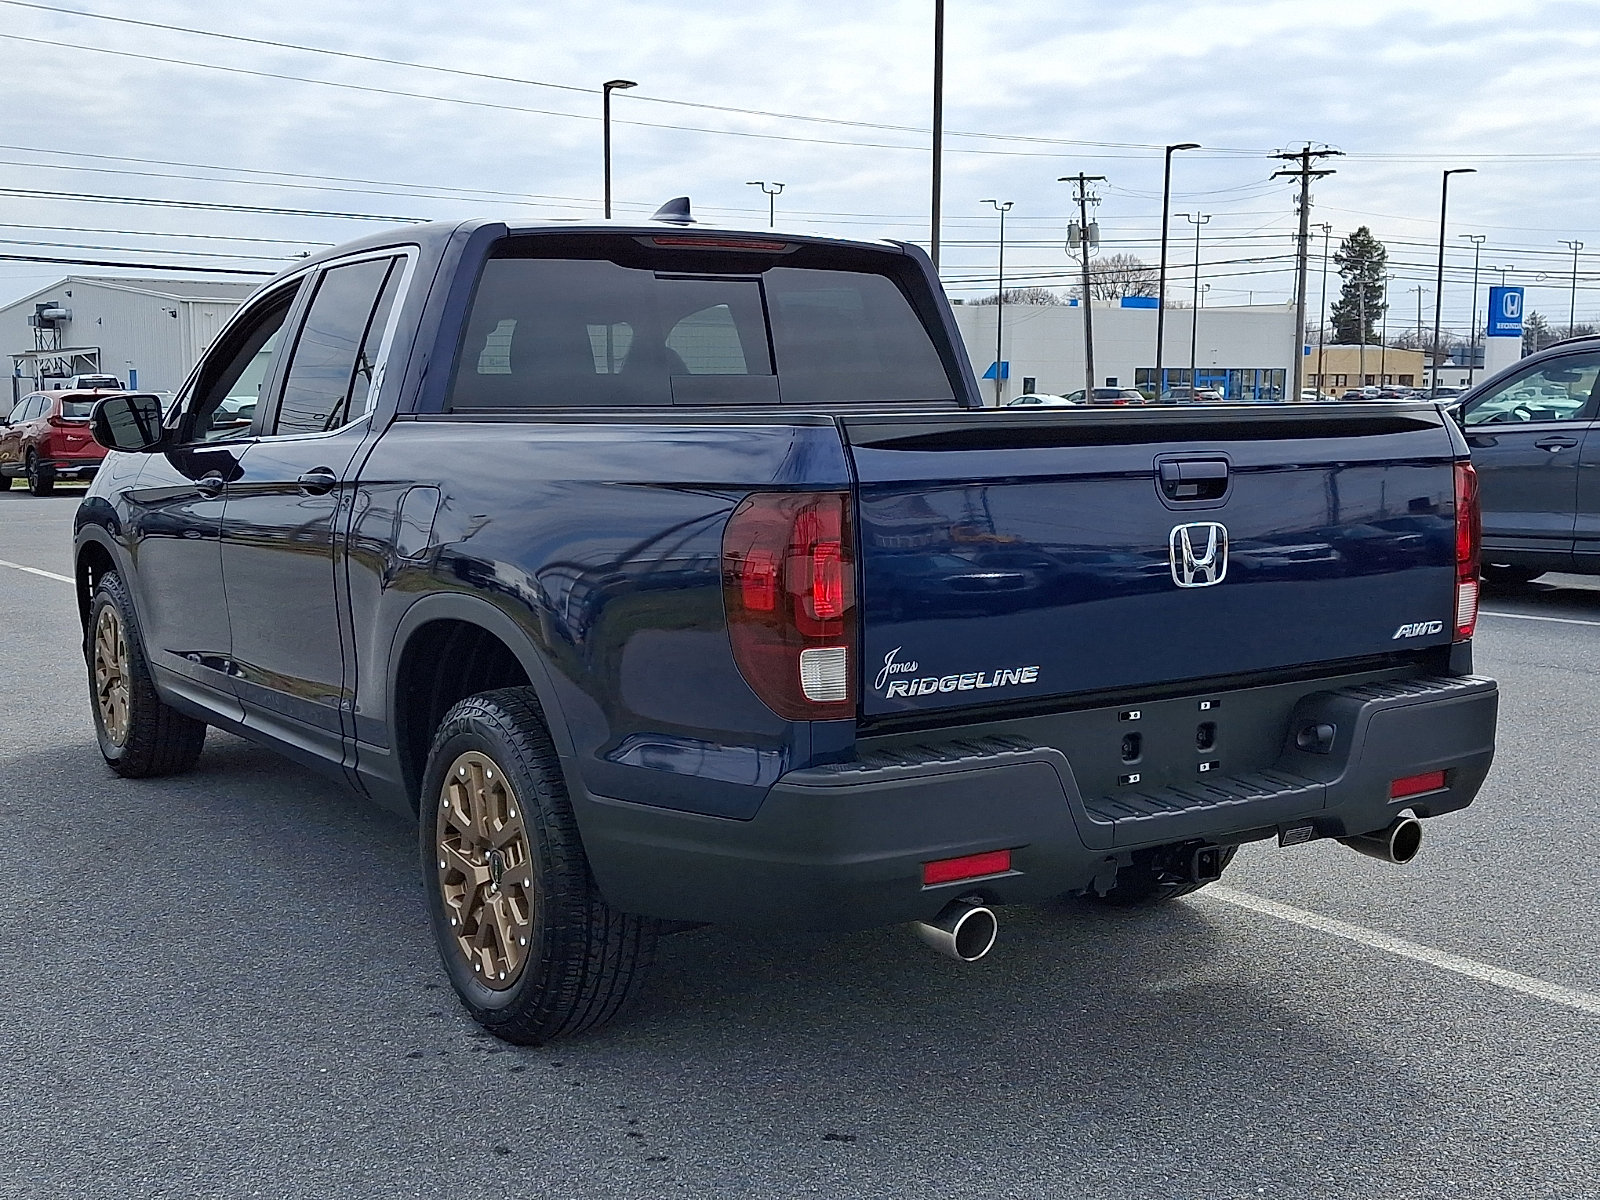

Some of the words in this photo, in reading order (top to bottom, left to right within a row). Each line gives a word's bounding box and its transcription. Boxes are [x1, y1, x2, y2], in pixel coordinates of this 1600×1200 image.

[1392, 620, 1443, 640] AWD
[875, 645, 919, 690] Jones
[886, 665, 1040, 699] RIDGELINE
